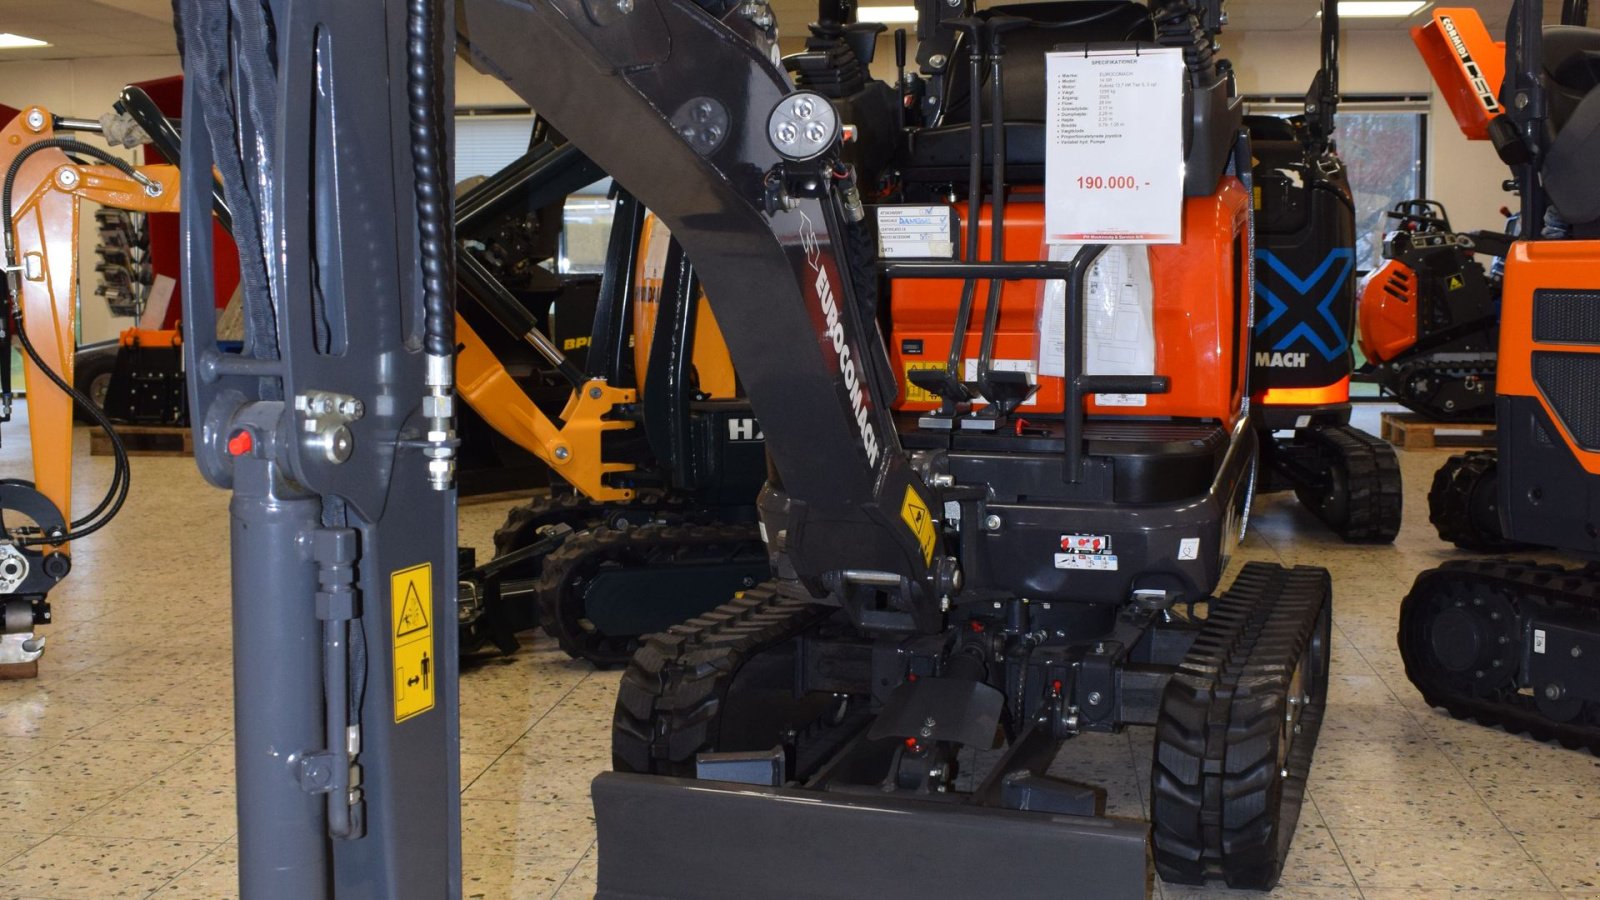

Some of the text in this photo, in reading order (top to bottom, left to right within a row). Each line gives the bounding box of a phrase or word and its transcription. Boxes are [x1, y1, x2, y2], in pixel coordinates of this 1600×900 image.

[1442, 17, 1470, 59] CORMIDI
[1077, 176, 1139, 191] 190.000,
[815, 264, 880, 469] EUROCOMACH
[1255, 351, 1306, 368] MACH
